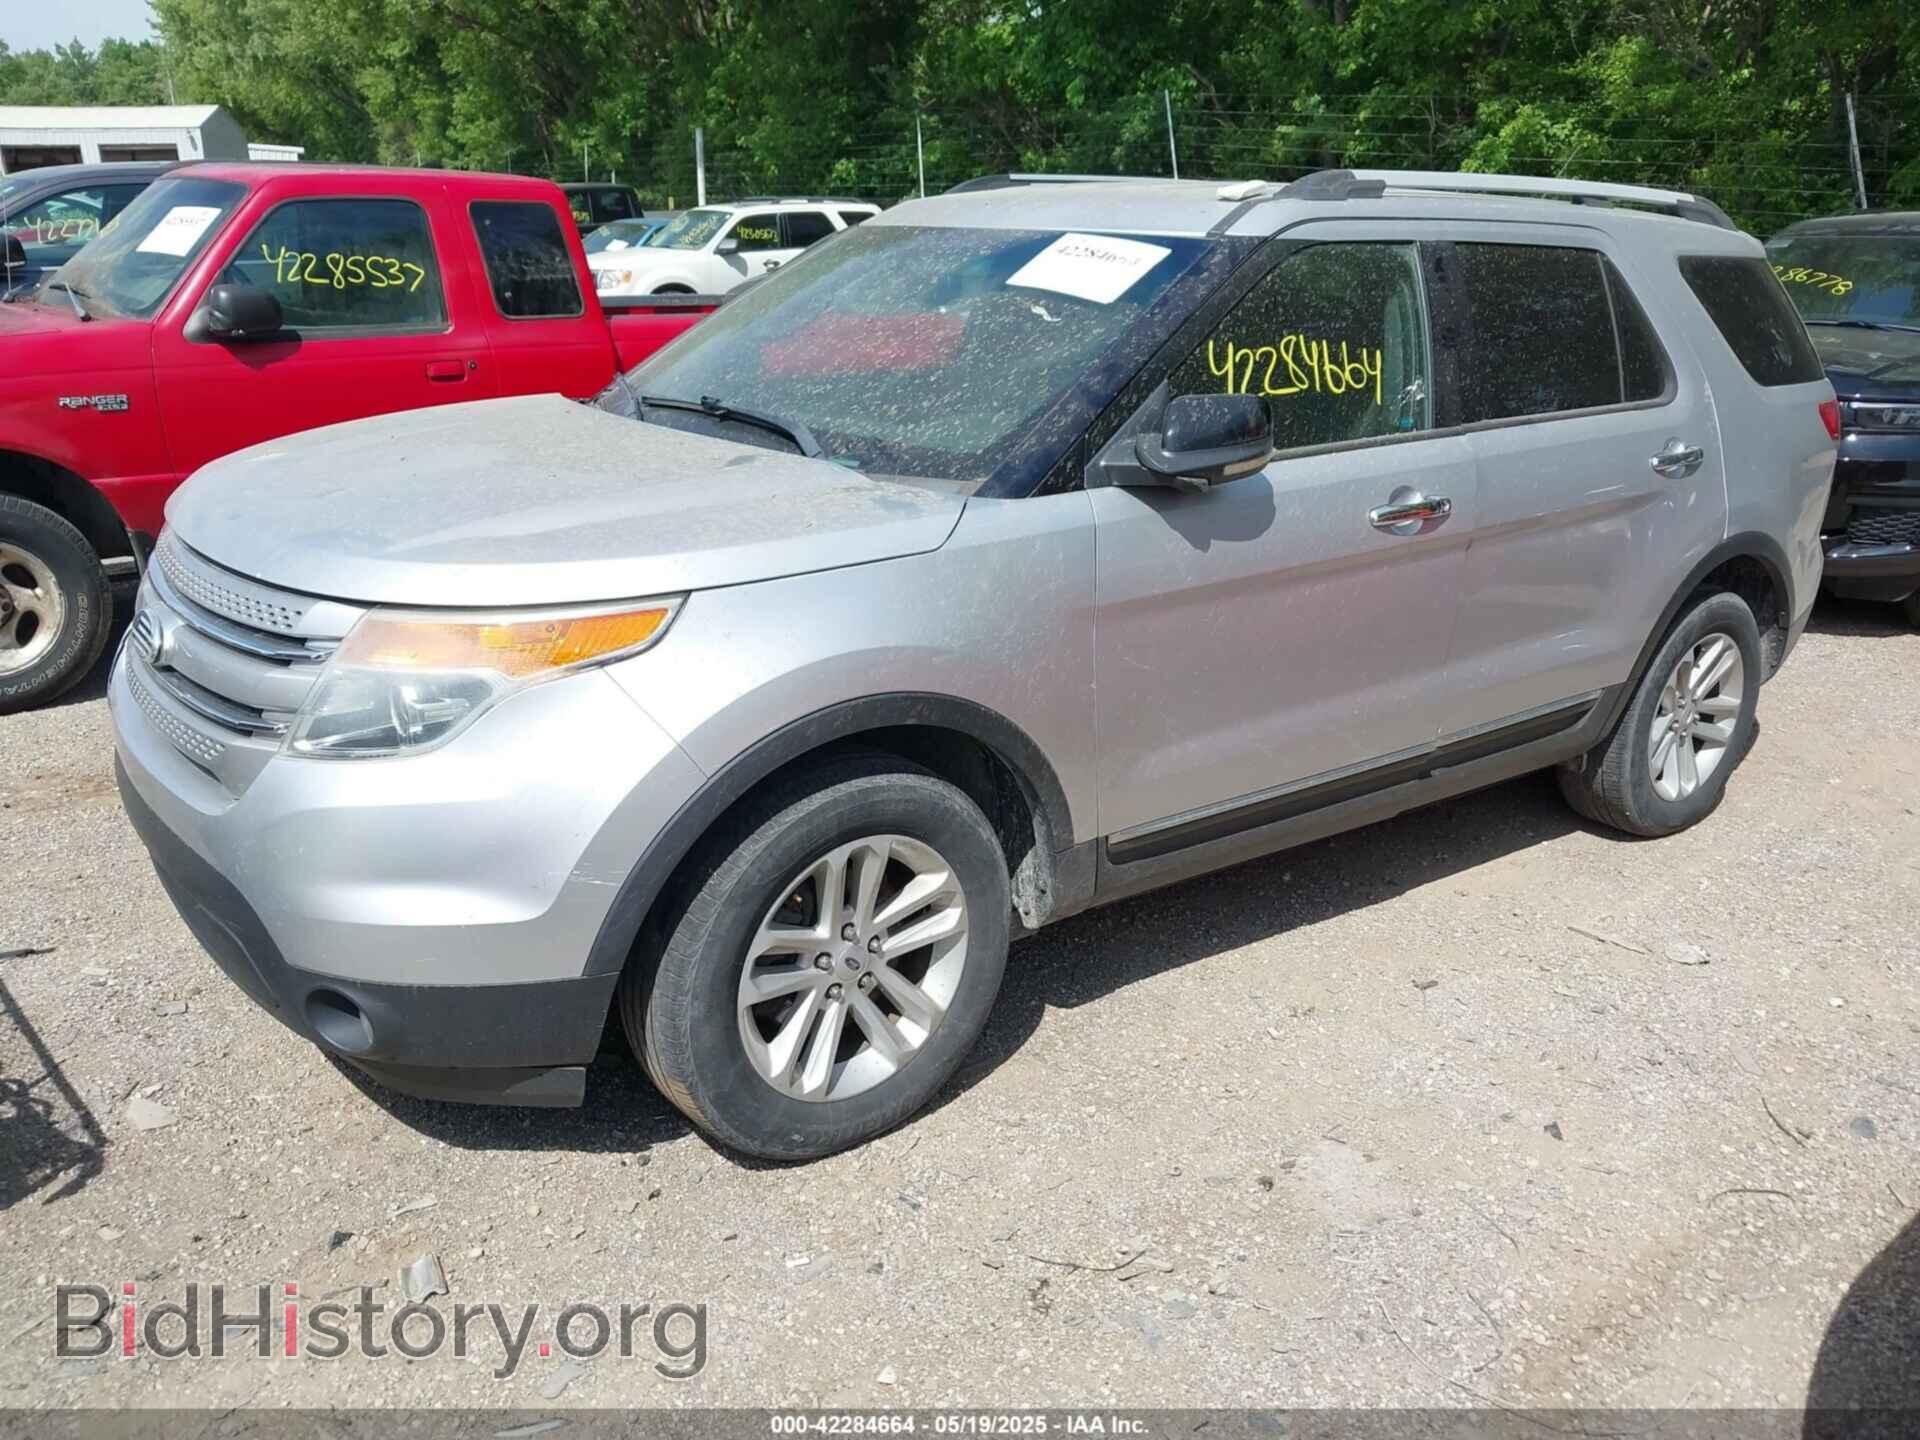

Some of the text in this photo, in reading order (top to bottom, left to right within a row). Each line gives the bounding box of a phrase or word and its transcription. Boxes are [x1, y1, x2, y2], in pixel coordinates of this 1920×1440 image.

[261, 243, 425, 293] 42285537
[1208, 334, 1382, 406] 42284664
[58, 393, 128, 409] RANGER
